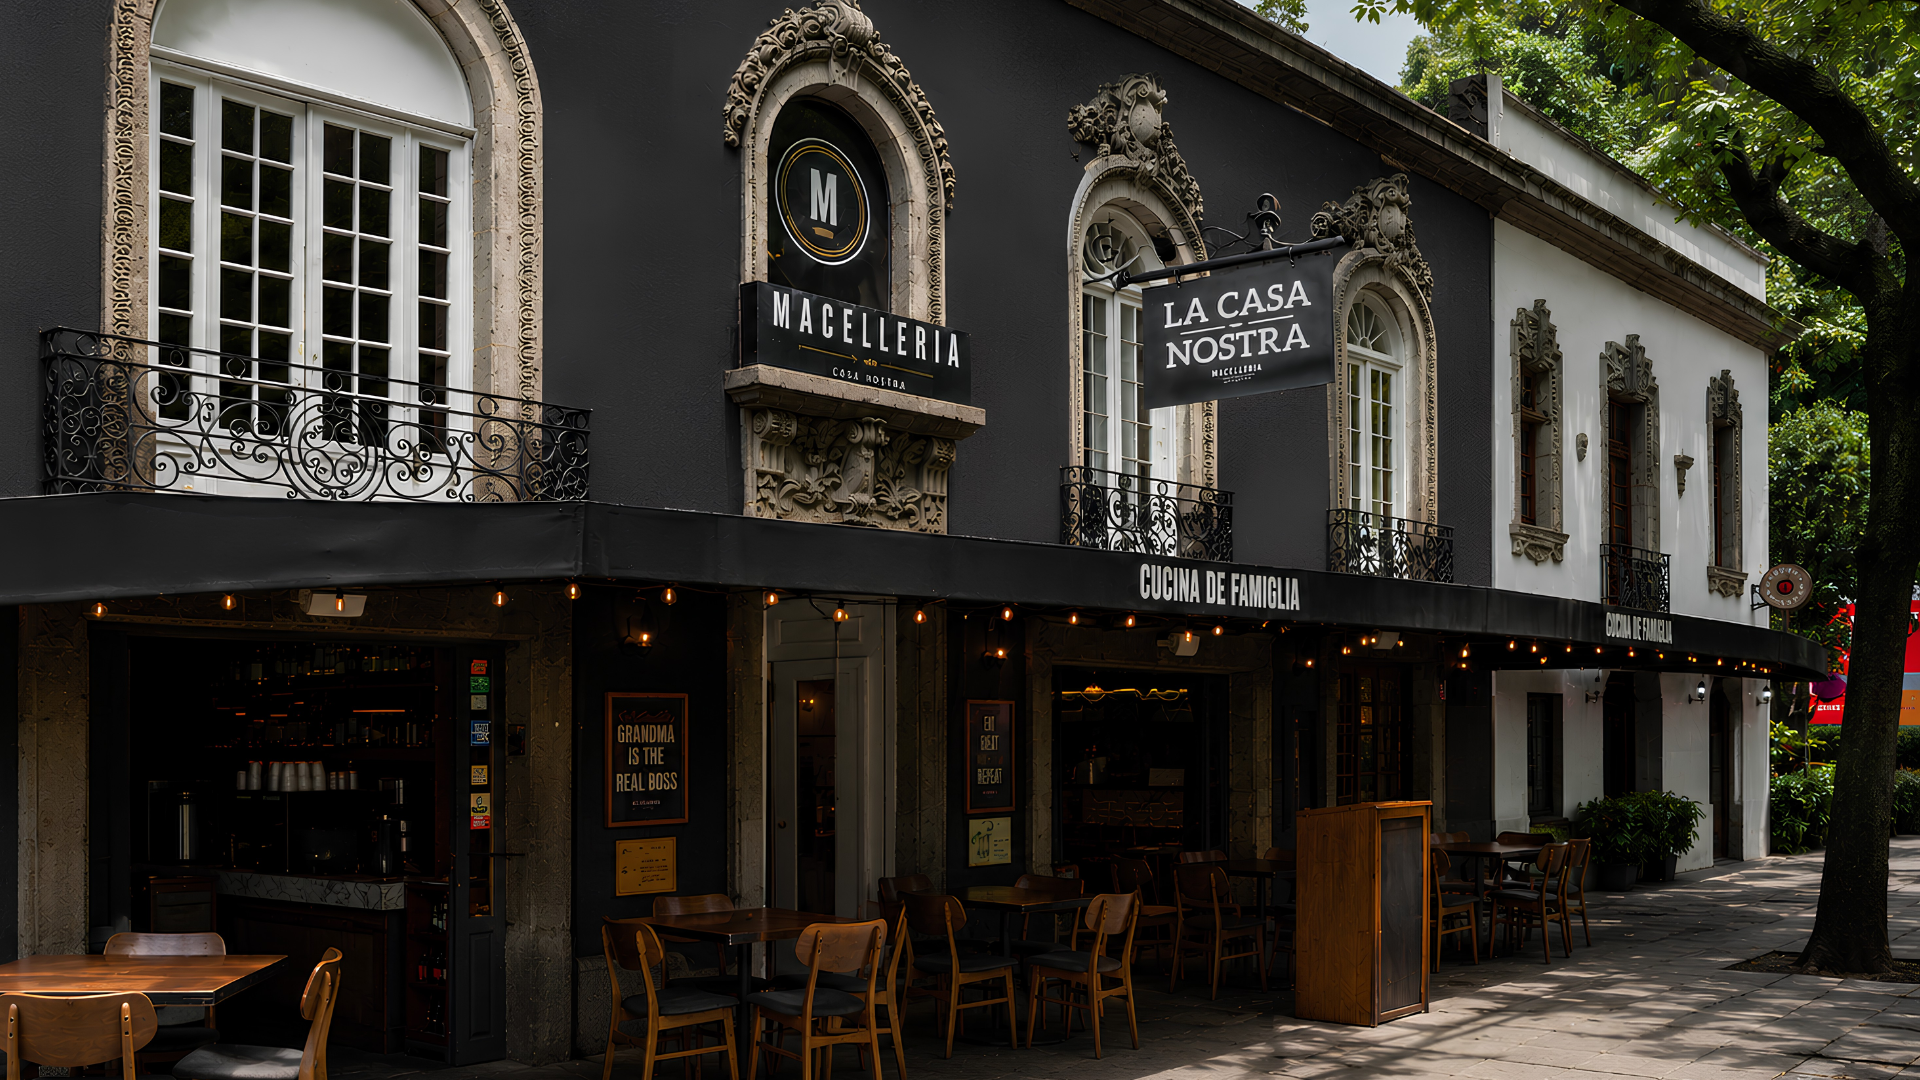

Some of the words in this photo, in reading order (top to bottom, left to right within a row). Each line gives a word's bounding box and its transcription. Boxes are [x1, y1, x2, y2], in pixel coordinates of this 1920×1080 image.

[810, 167, 838, 227] M
[1163, 297, 1208, 329] LA
[1217, 280, 1312, 319] CASA
[773, 290, 960, 368] MACELLERIA
[1165, 322, 1310, 369] NOSTRA
[1139, 563, 1201, 604] CUCINA
[1206, 570, 1227, 606] DE
[1231, 572, 1301, 611] FAMIGLIA
[617, 724, 675, 744] GRANDMA
[628, 747, 640, 766] IS
[642, 746, 665, 765] THE
[616, 773, 646, 793] REAL
[648, 771, 678, 792] BOSS
